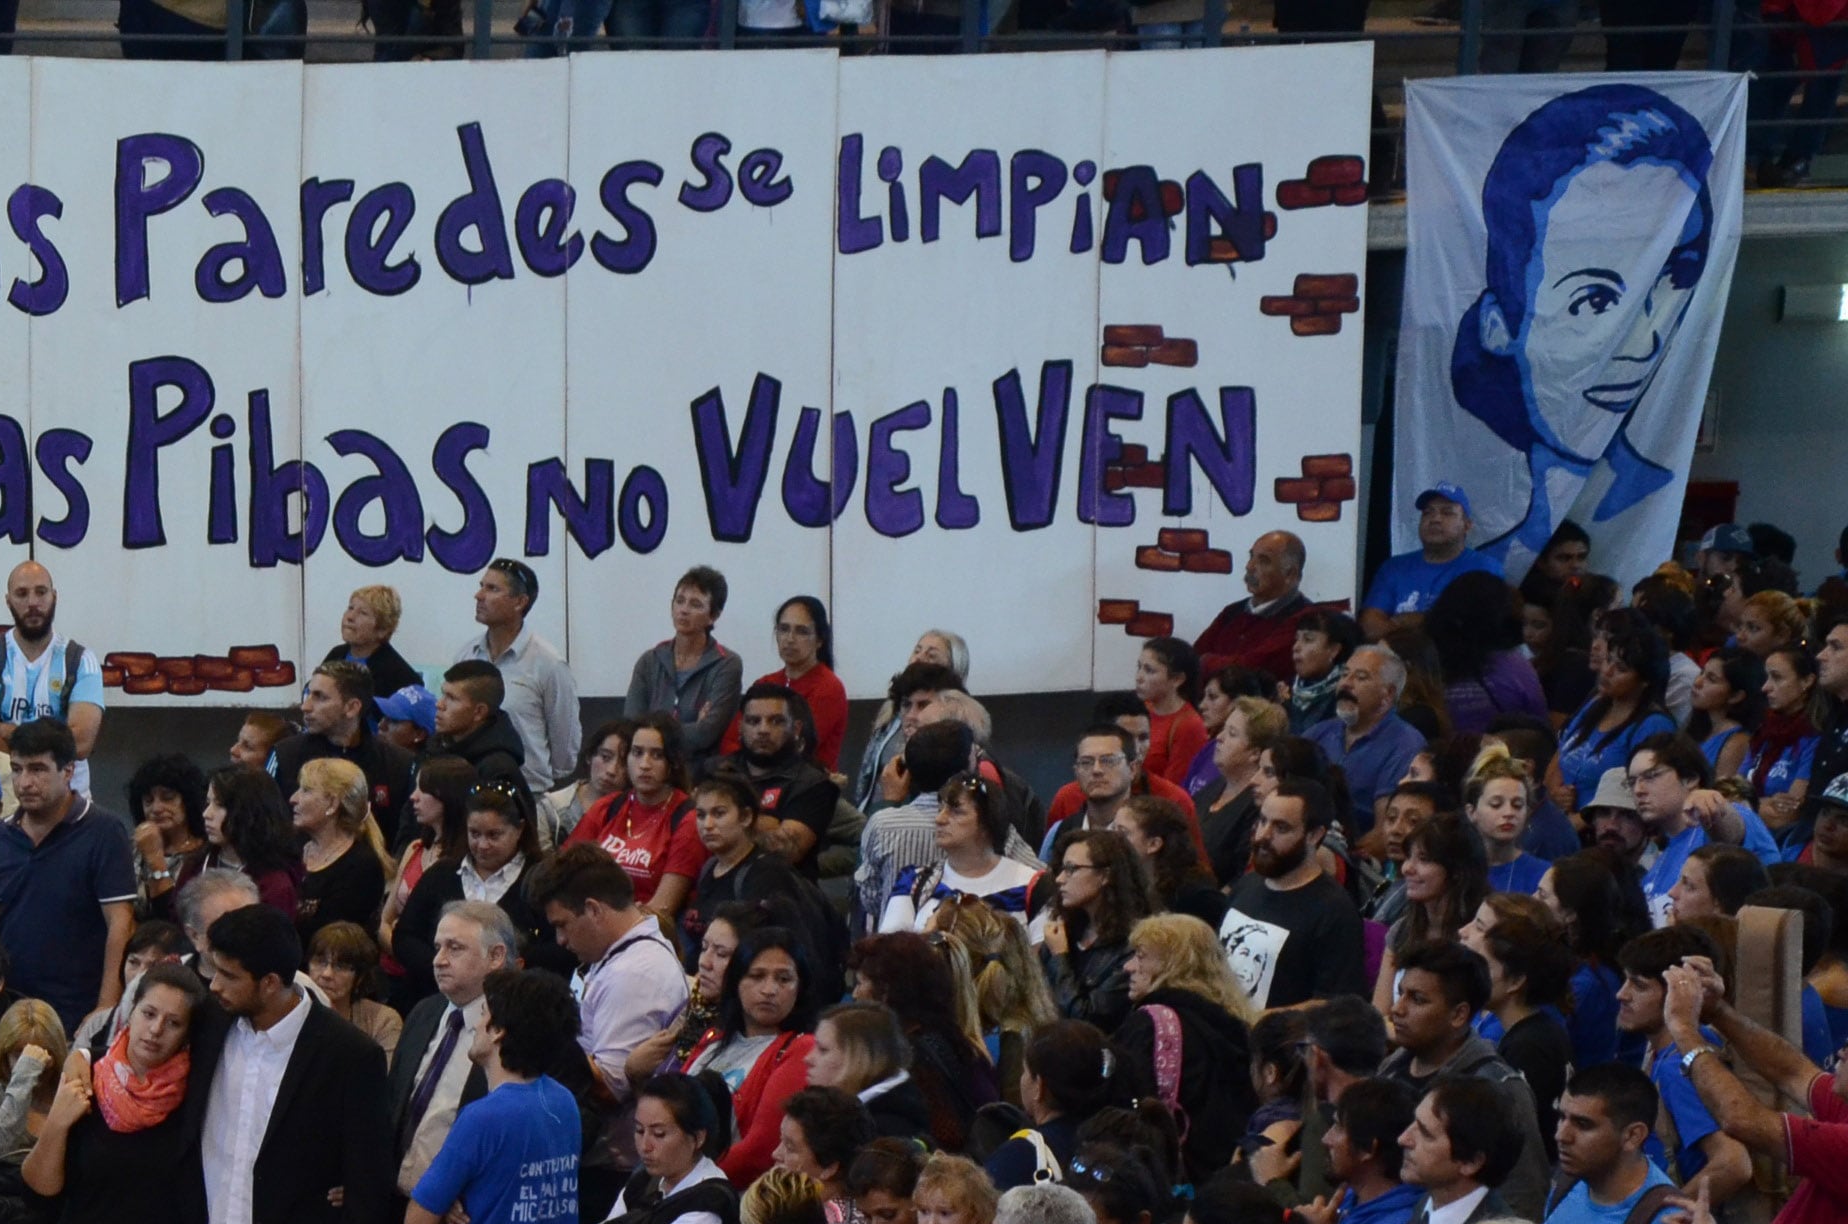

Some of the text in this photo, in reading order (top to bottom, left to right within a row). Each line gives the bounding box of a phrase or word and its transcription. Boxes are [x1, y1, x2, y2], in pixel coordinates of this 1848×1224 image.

[114, 121, 665, 308] Paredes
[123, 355, 497, 575] Pibas
[690, 358, 1257, 545] VUELVEN
